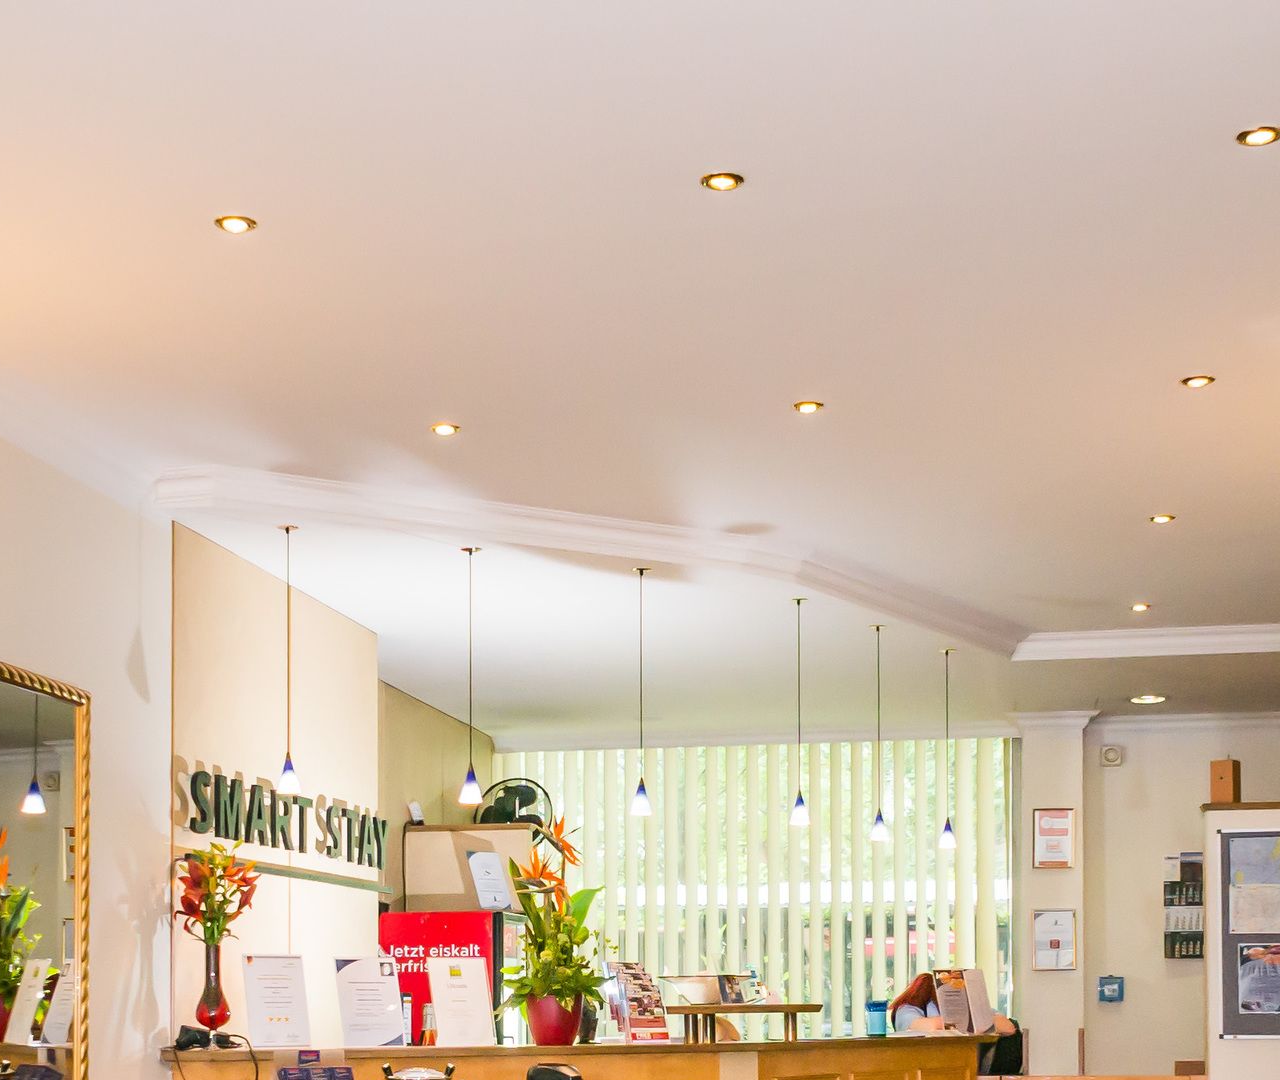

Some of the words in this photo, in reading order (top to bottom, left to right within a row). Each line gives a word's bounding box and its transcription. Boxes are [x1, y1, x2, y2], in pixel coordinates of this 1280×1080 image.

[190, 770, 313, 853] SMART
[325, 805, 388, 870] STAY
[387, 944, 424, 958] Jetzt
[429, 944, 480, 957] eiskalt
